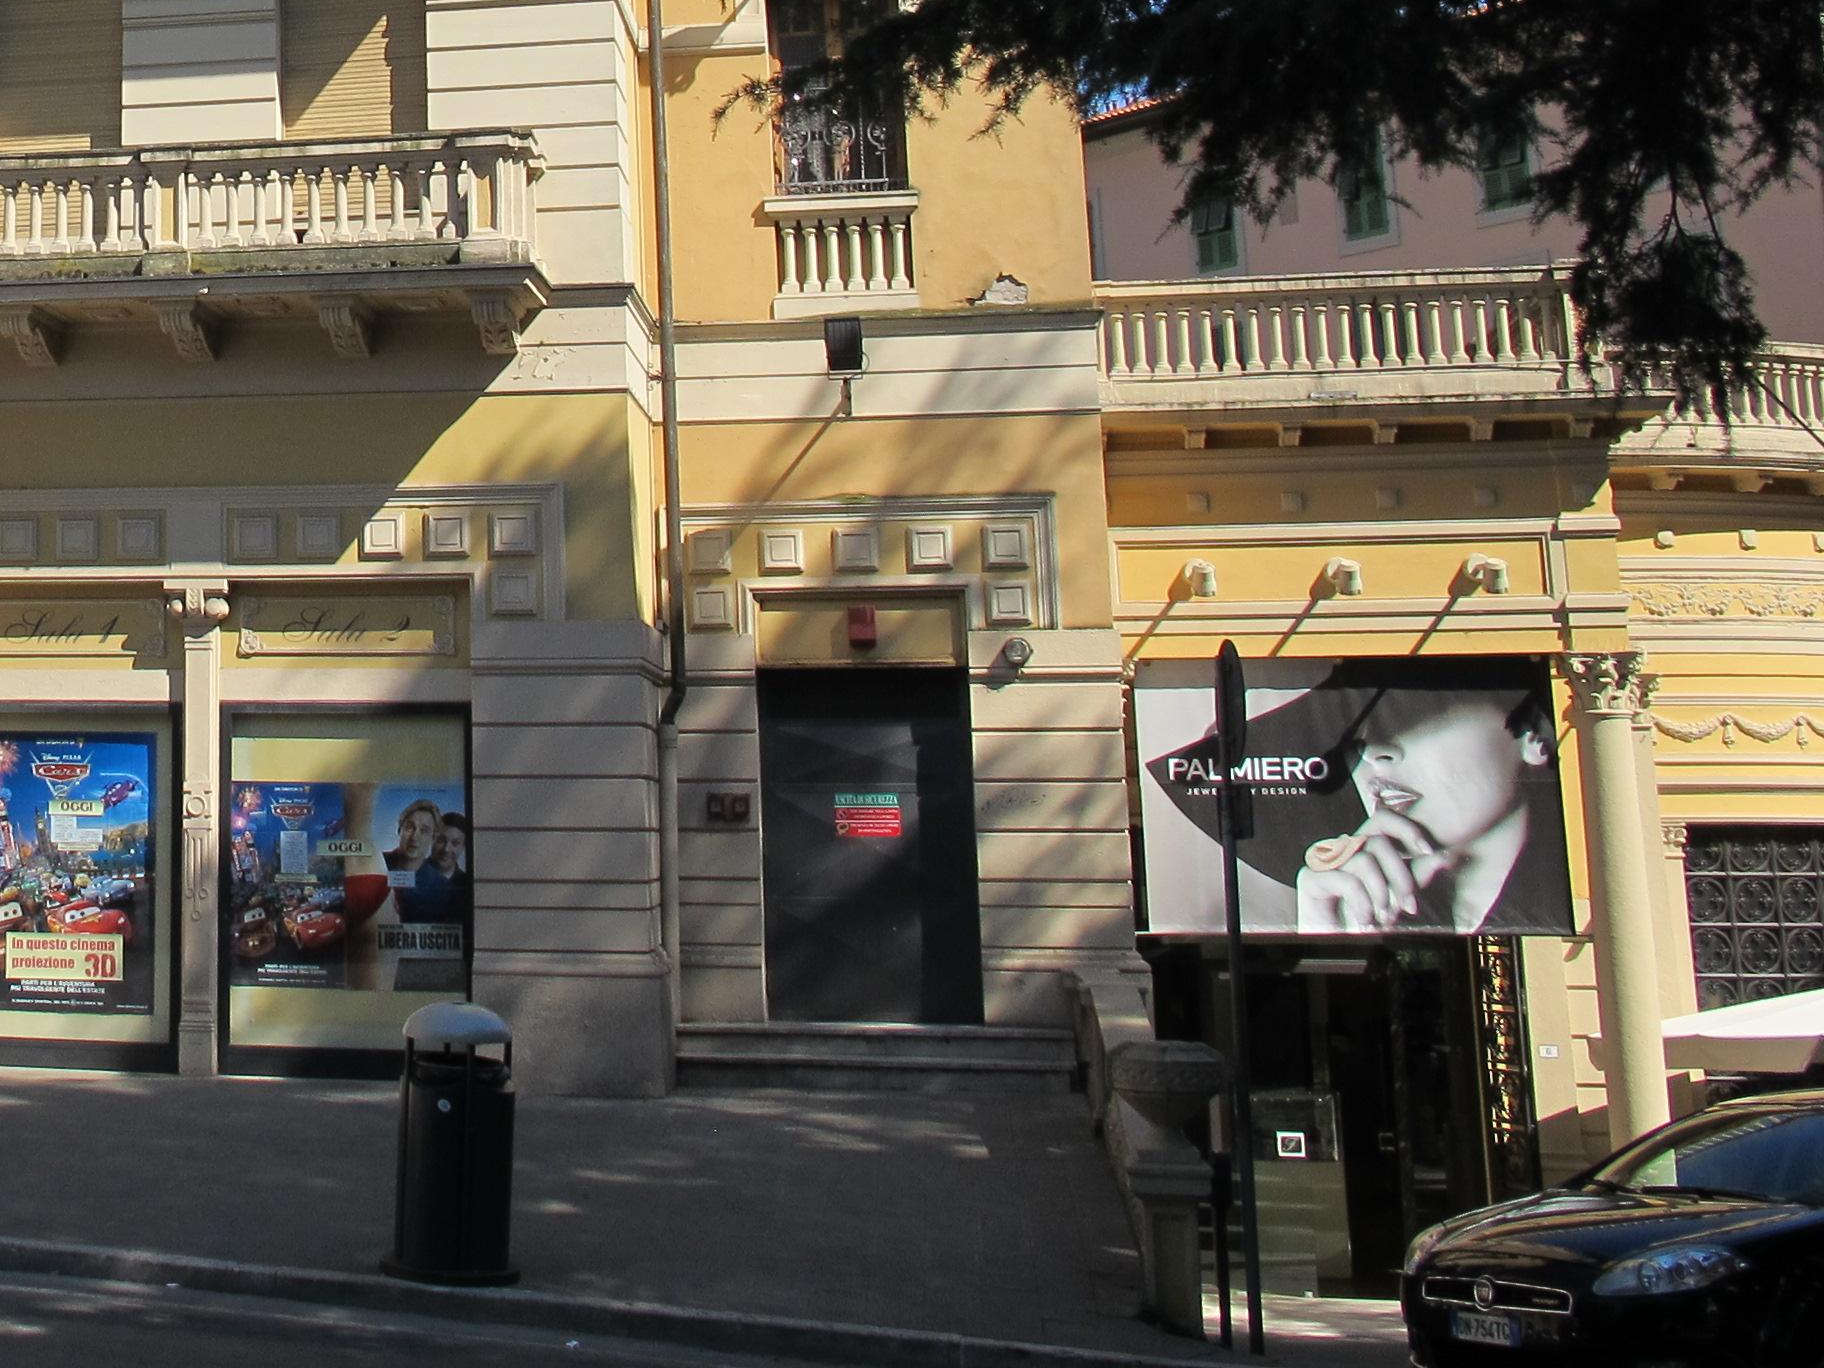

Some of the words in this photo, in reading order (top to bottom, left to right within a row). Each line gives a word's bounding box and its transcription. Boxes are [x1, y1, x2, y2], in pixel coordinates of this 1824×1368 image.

[5, 607, 82, 644] Sala
[96, 614, 120, 644] 1
[282, 605, 367, 644] Sala
[379, 614, 411, 643] 2
[38, 764, 84, 777] Cars
[1167, 756, 1328, 781] PALMIERO
[1261, 787, 1307, 796] DESIGN
[60, 800, 93, 812] OGGI
[328, 842, 362, 853] OGGI
[11, 937, 23, 950] In
[26, 938, 68, 953] questo
[70, 938, 115, 951] cinema
[378, 932, 417, 950] LIBERA
[419, 933, 460, 950] USCITA
[12, 957, 75, 969] proiezione
[84, 953, 117, 978] 3D
